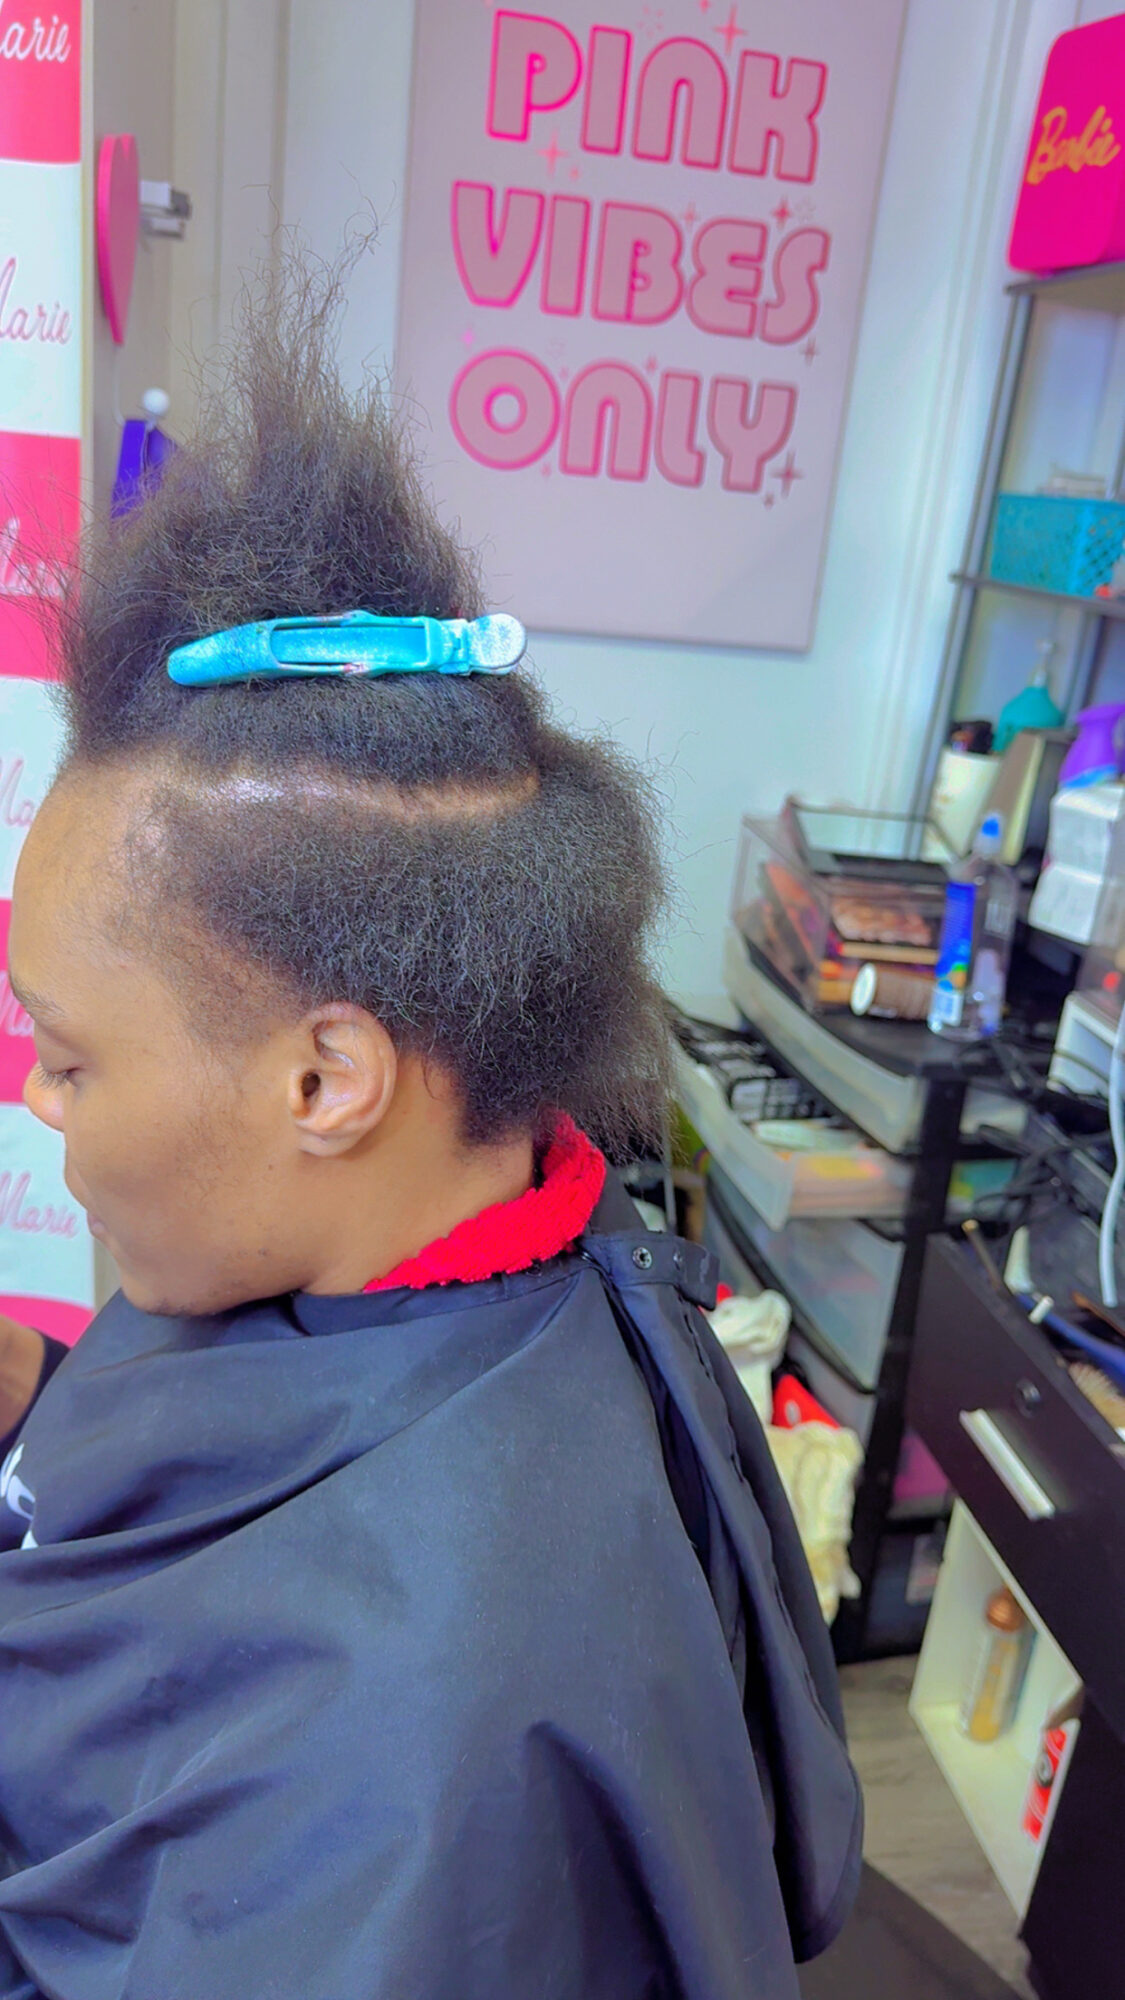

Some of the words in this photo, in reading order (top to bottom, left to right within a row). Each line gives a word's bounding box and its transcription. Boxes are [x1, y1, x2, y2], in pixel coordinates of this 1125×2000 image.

[0, 0, 71, 63] arie
[485, 8, 828, 185] PINK
[1026, 105, 1121, 185] Barbie
[450, 180, 831, 346] VIBES
[449, 347, 797, 493] ONLY
